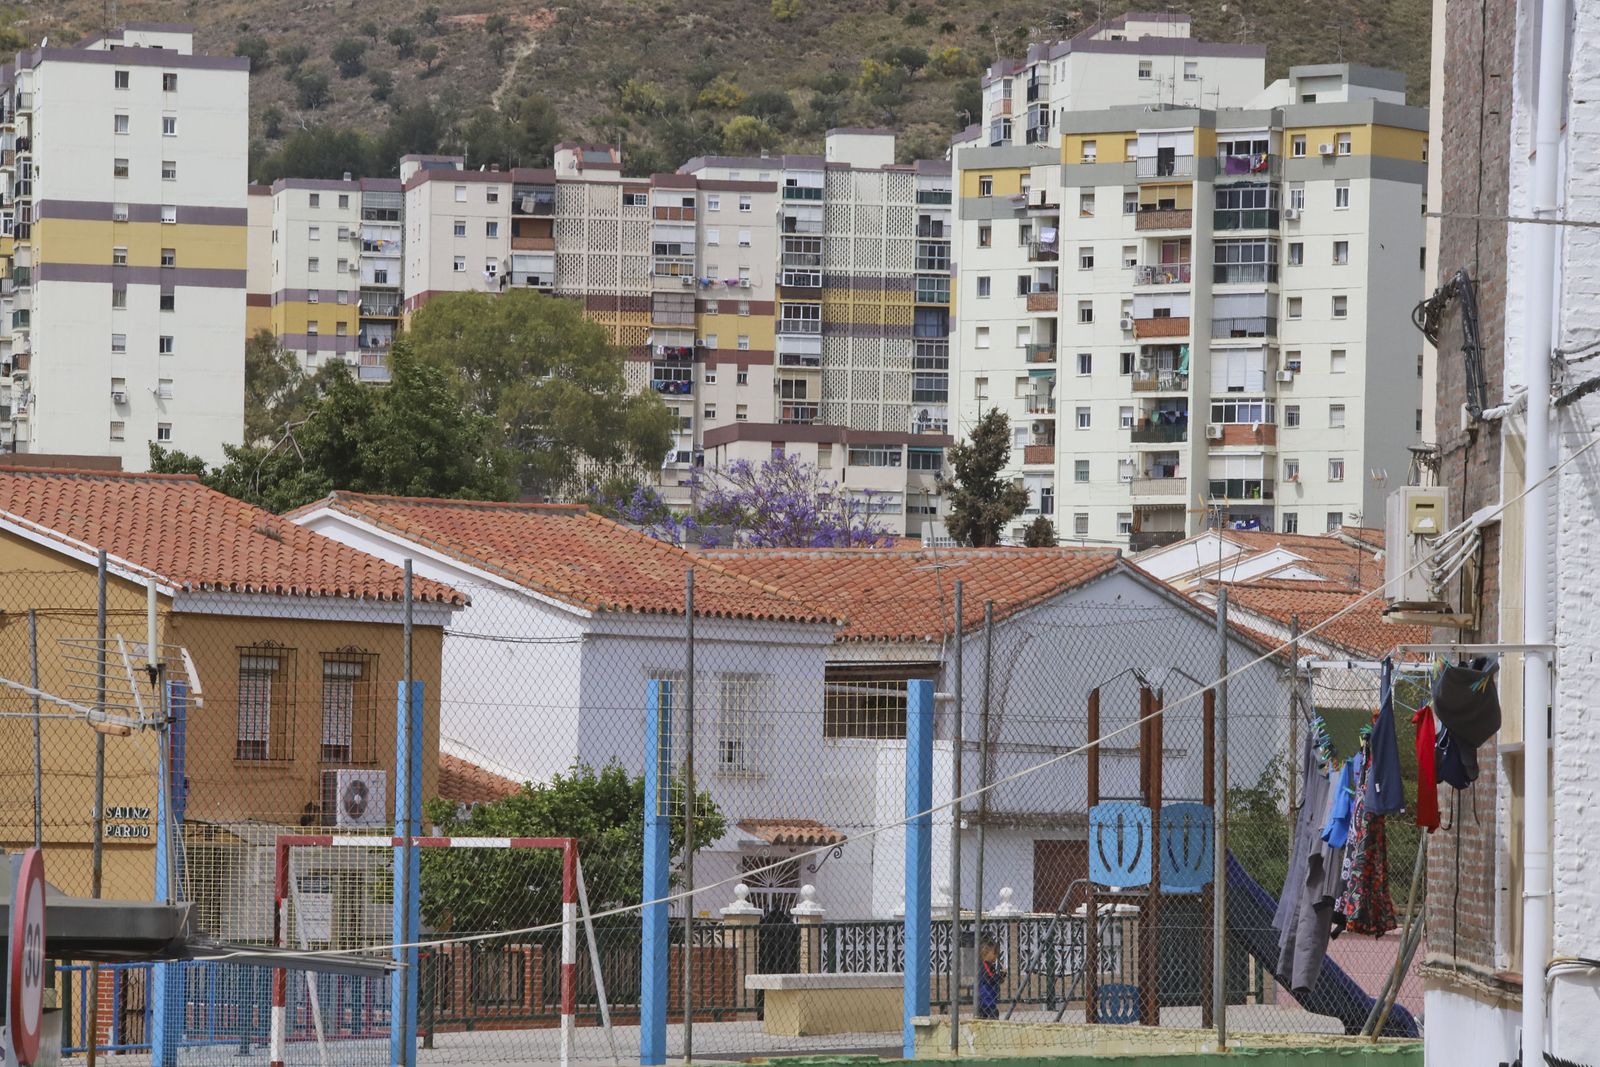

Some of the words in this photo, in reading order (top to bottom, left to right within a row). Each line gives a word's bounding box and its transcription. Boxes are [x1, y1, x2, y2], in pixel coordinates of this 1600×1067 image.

[106, 806, 150, 819] SAINZ
[104, 824, 150, 838] PARDO
[25, 922, 41, 988] 30
